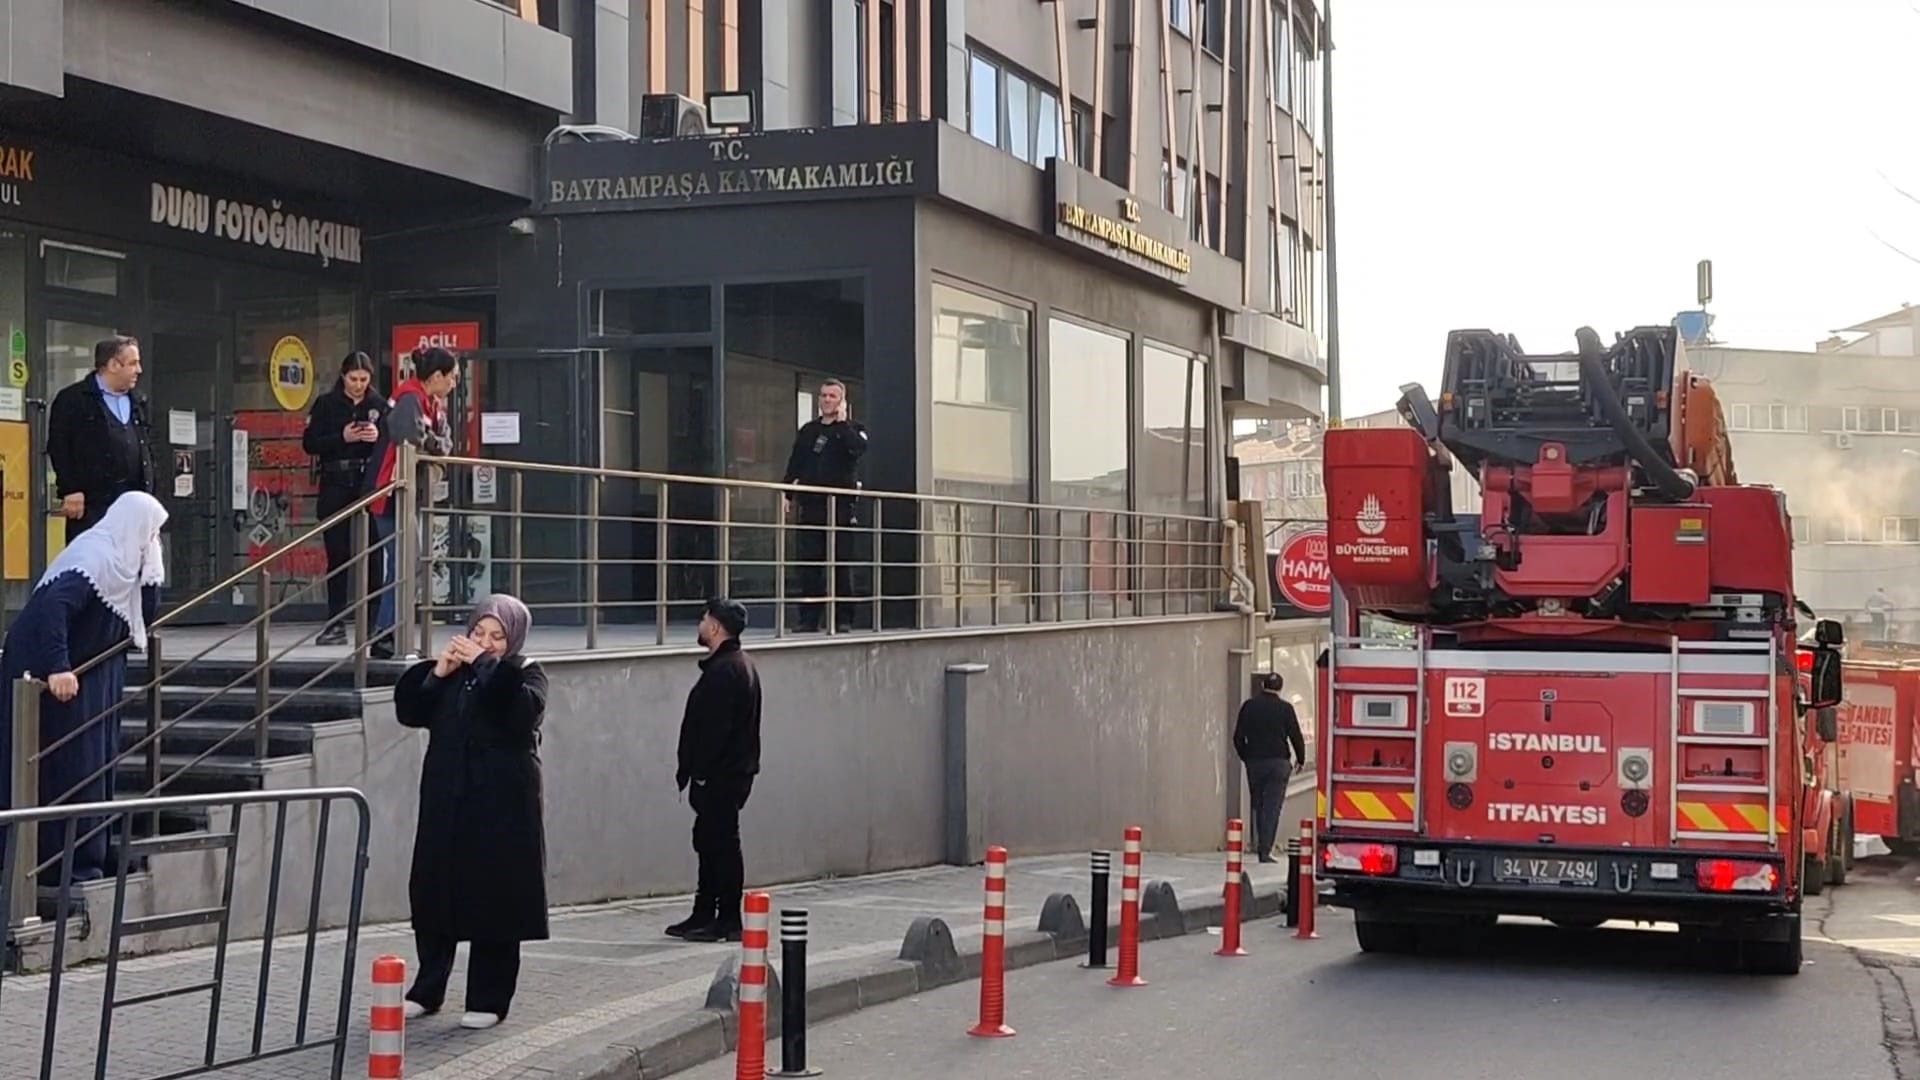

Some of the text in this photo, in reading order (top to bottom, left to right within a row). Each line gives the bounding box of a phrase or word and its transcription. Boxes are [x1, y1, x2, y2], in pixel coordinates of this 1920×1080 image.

[551, 154, 914, 201] BAYRAMPAŞA KAYMAKAMLIĞI
[151, 182, 361, 268] DURU FOTOĞRAFÇILIK
[1452, 682, 1478, 699] 112
[1503, 859, 1594, 878] 34 VZ 7494
